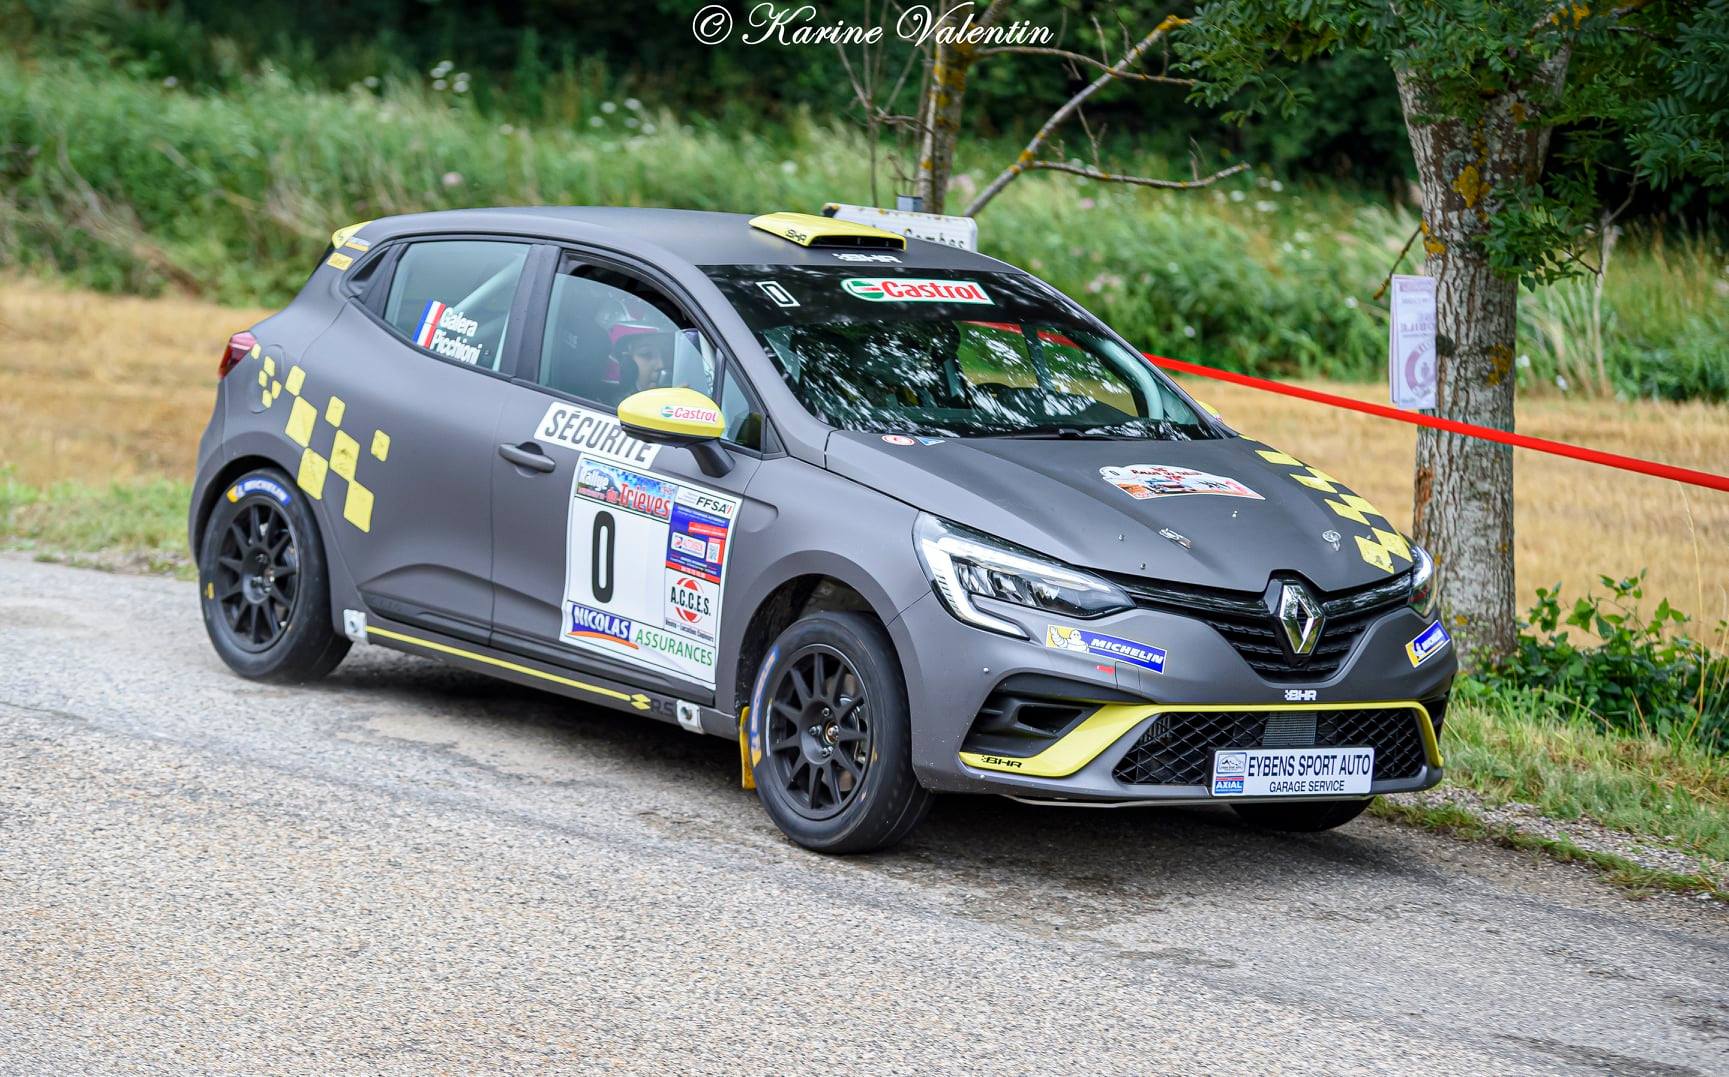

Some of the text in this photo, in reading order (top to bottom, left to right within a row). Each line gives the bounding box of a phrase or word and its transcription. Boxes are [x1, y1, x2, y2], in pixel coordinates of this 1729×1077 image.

[881, 281, 988, 301] Castrol
[674, 407, 717, 423] Castrol
[620, 483, 671, 518] Trièves
[696, 496, 727, 514] FFSA
[592, 510, 616, 603] 0
[573, 605, 713, 667] NICOLAS ASSURANCES
[1091, 638, 1164, 665] MICHELIN
[1248, 754, 1371, 777] EYBENS SPORT AUTO
[1216, 781, 1242, 789] AXIAL
[1269, 780, 1345, 793] GARAGE SERVICE
